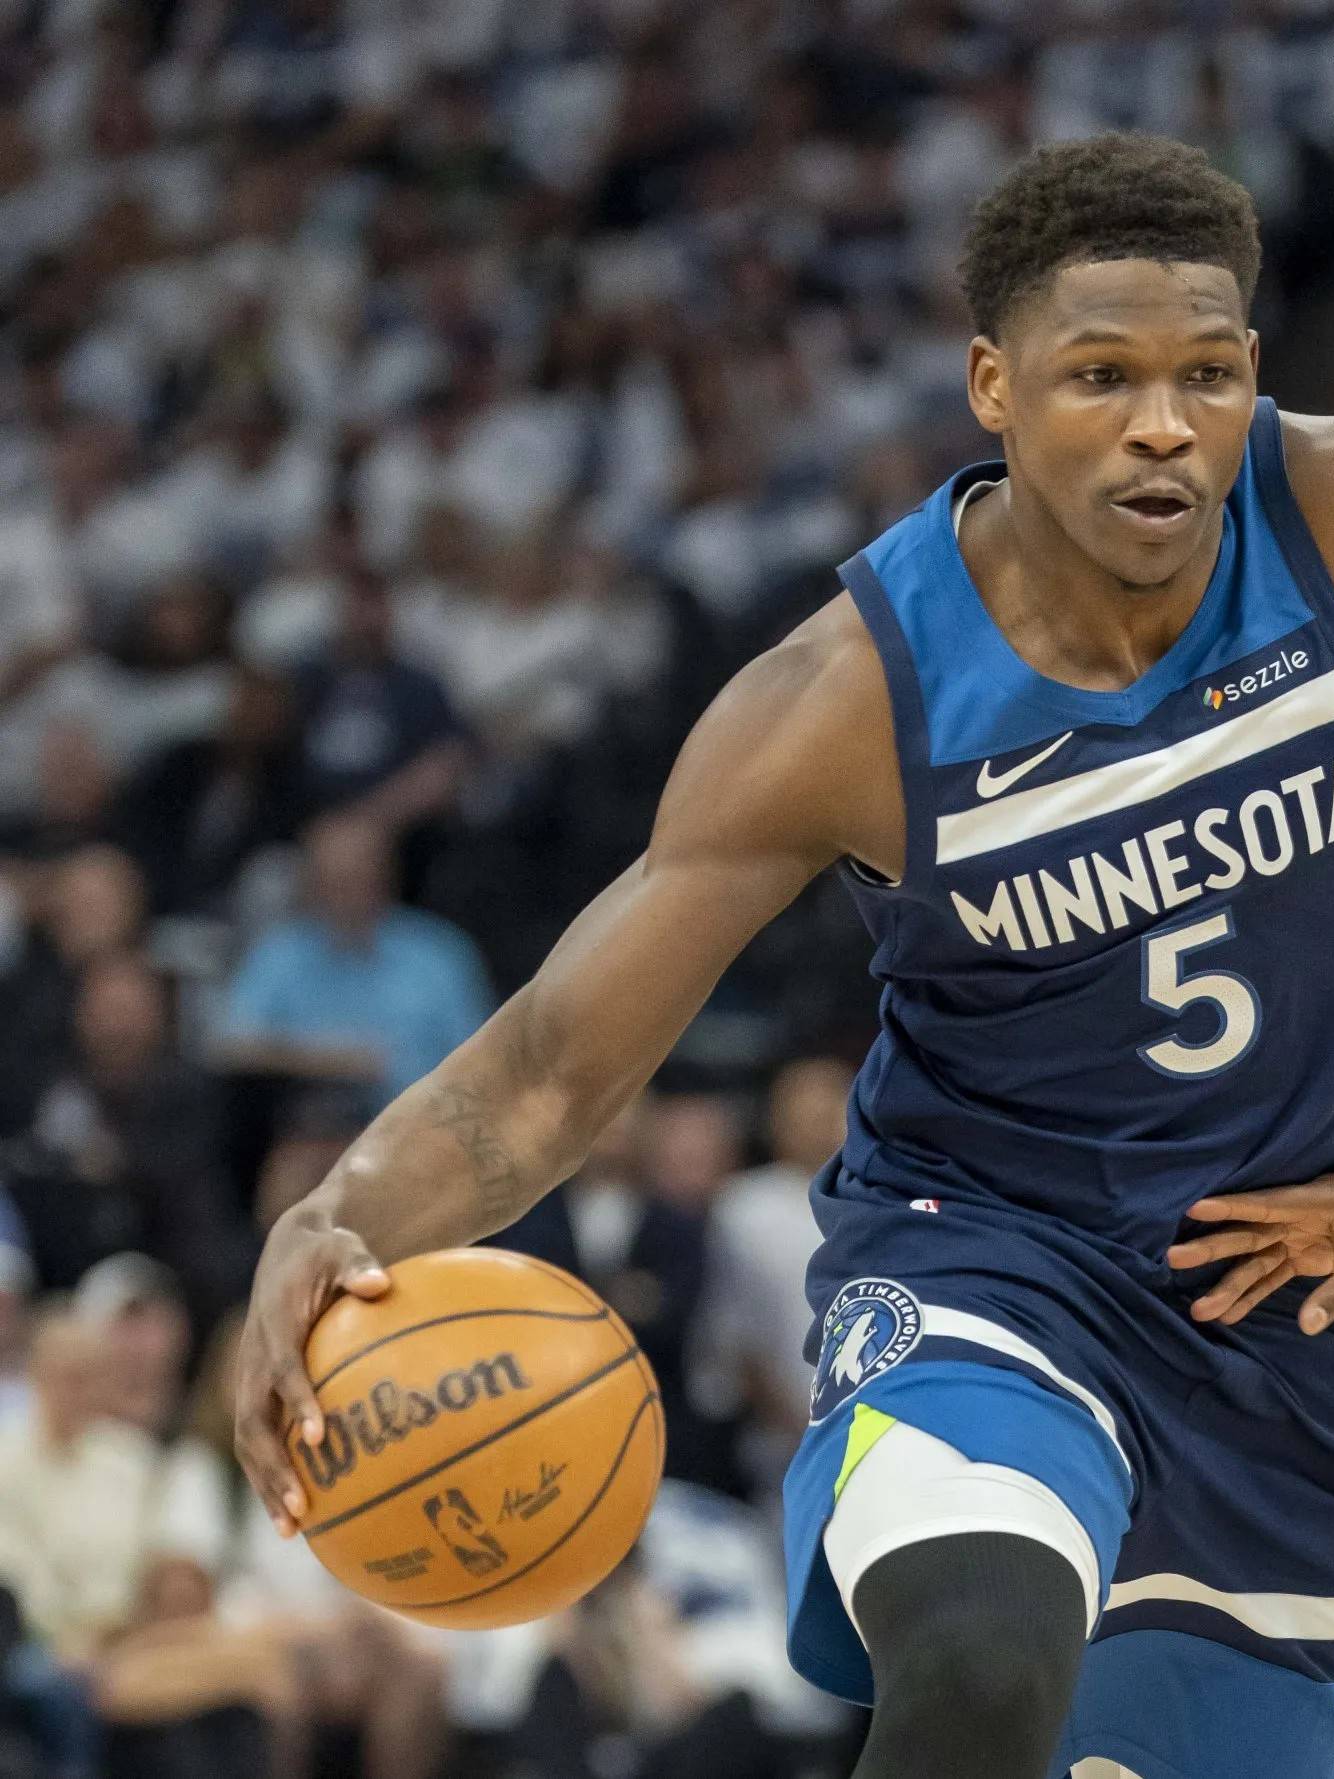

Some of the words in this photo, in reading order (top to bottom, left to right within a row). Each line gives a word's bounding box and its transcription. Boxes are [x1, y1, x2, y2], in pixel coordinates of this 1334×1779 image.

[1224, 649, 1309, 702] sezzle
[1136, 905, 1262, 1081] 5
[857, 1284, 918, 1371] TIMBERWOLVES
[297, 1352, 531, 1489] Wilson
